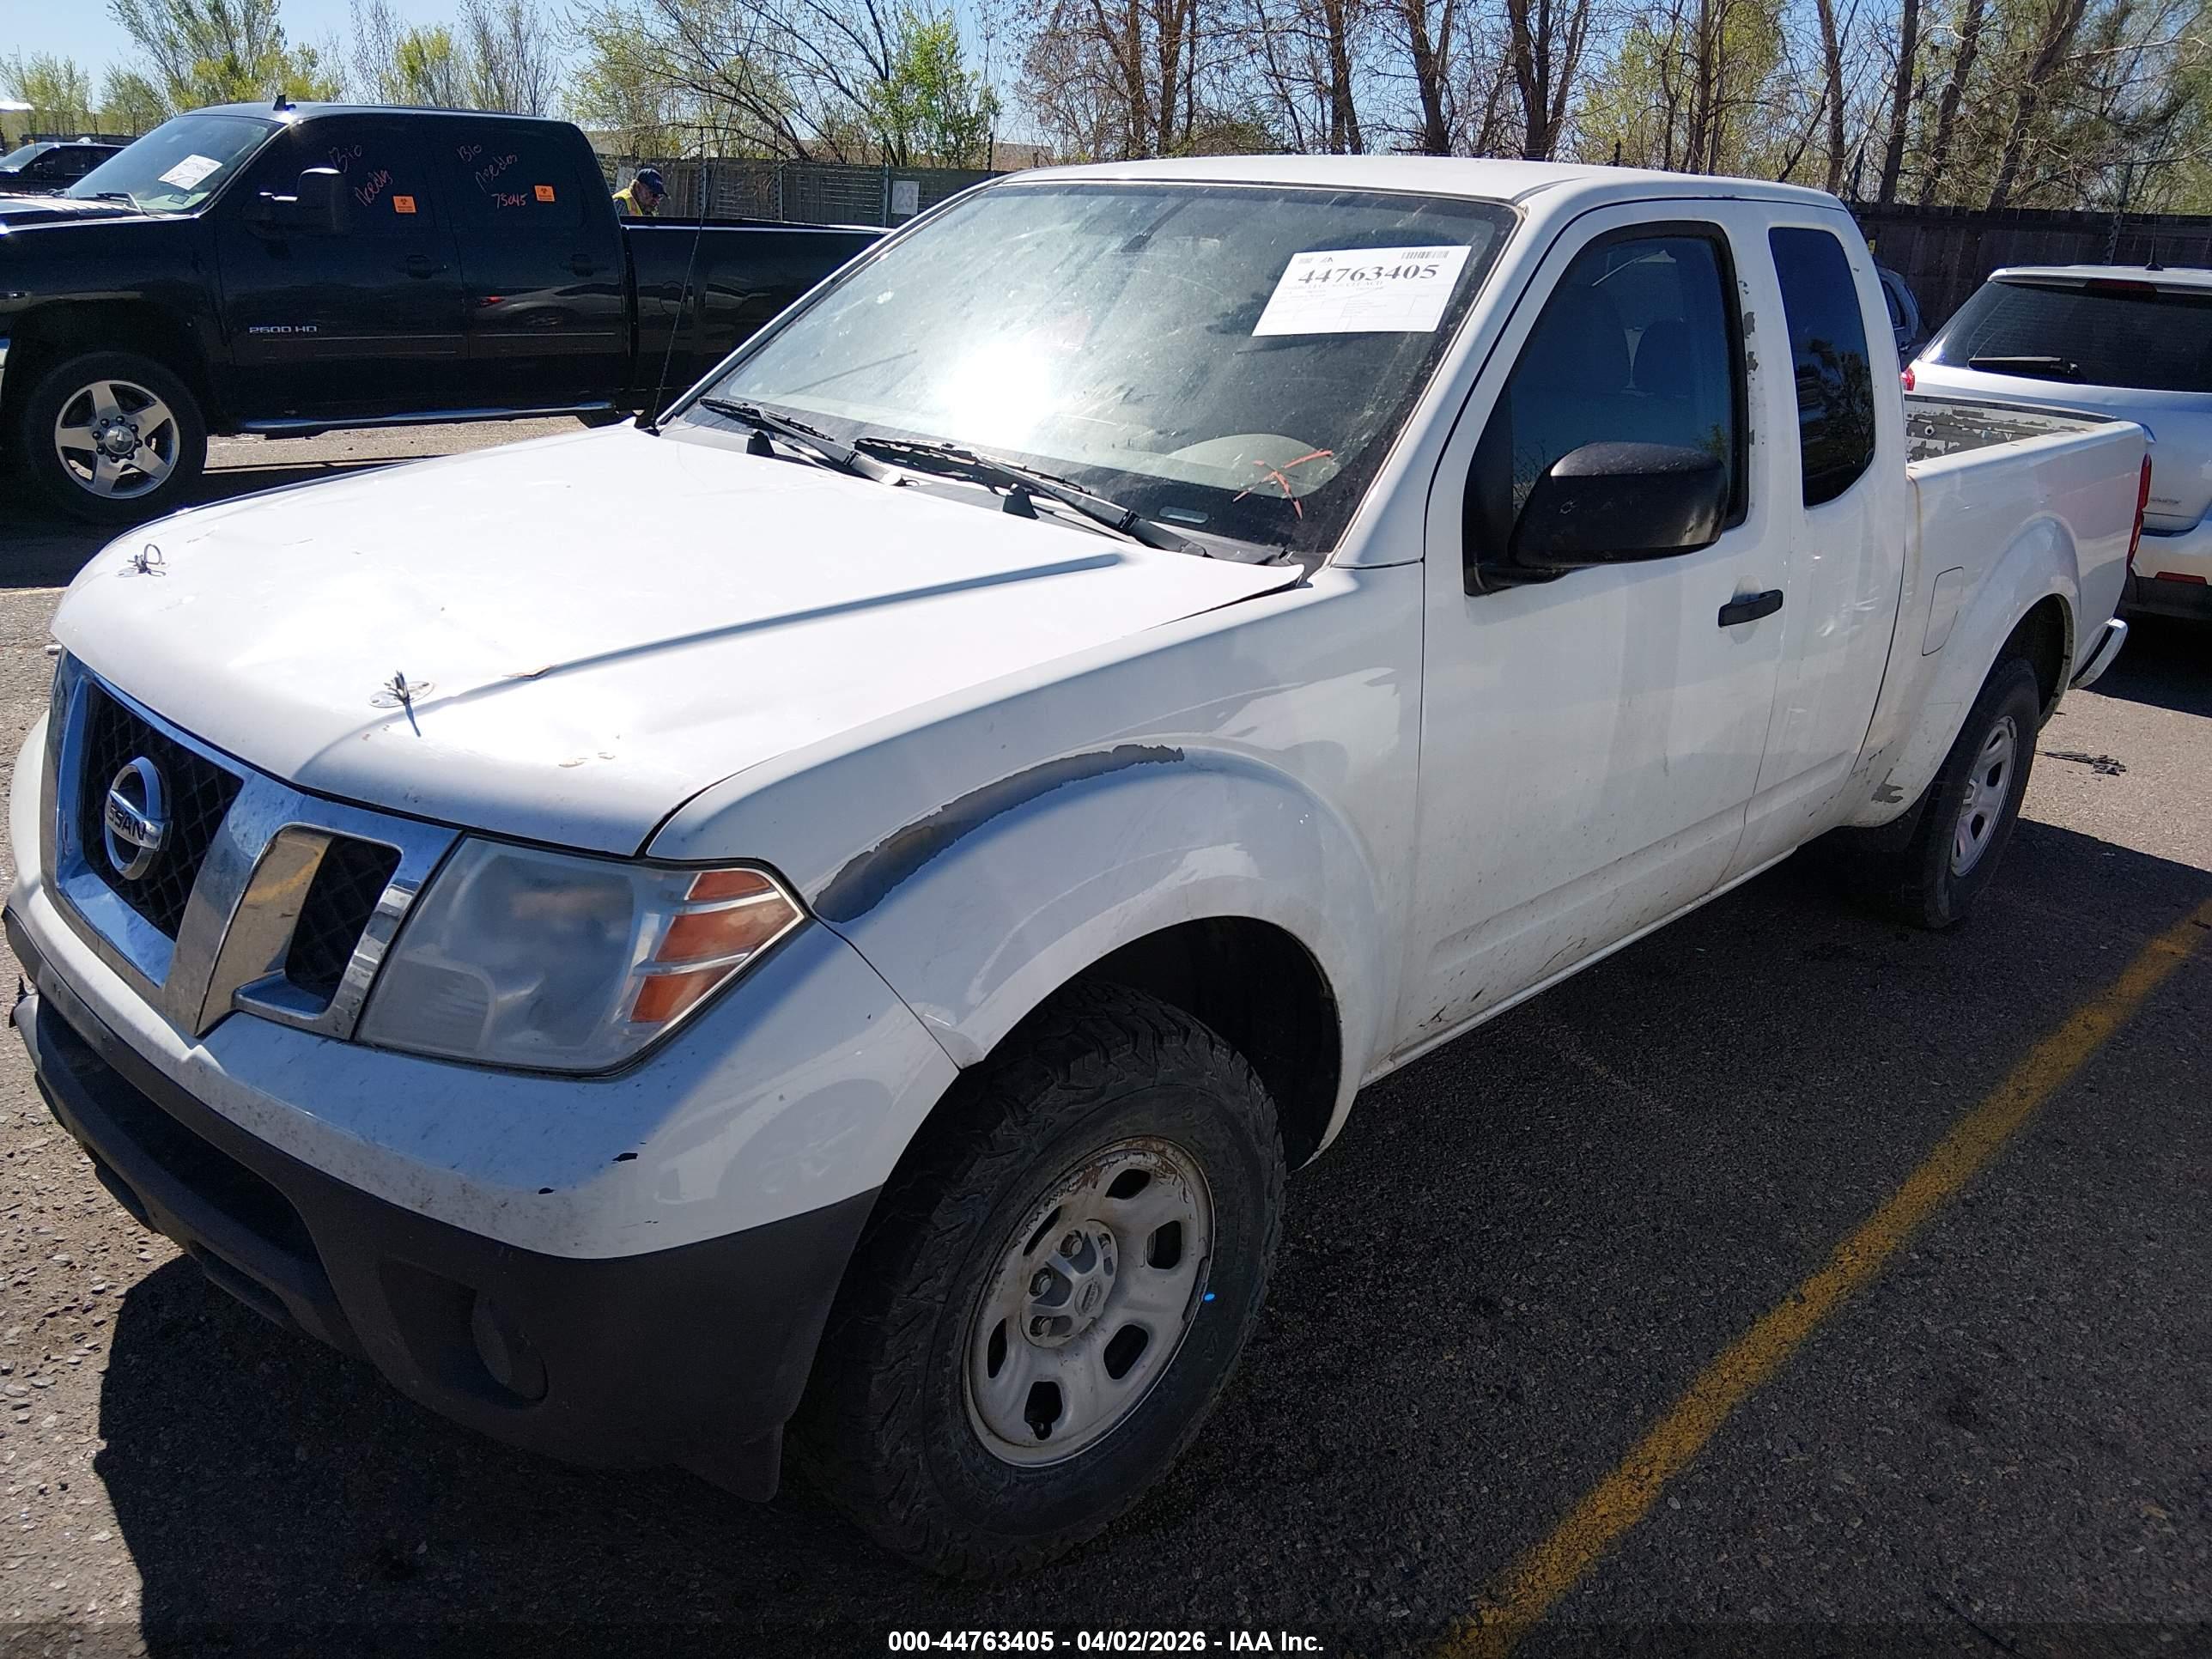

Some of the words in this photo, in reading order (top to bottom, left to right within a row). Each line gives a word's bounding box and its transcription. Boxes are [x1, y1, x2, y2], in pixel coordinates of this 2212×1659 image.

[327, 144, 362, 173] Bio
[896, 185, 915, 207] 23
[1297, 264, 1439, 284] 44763405
